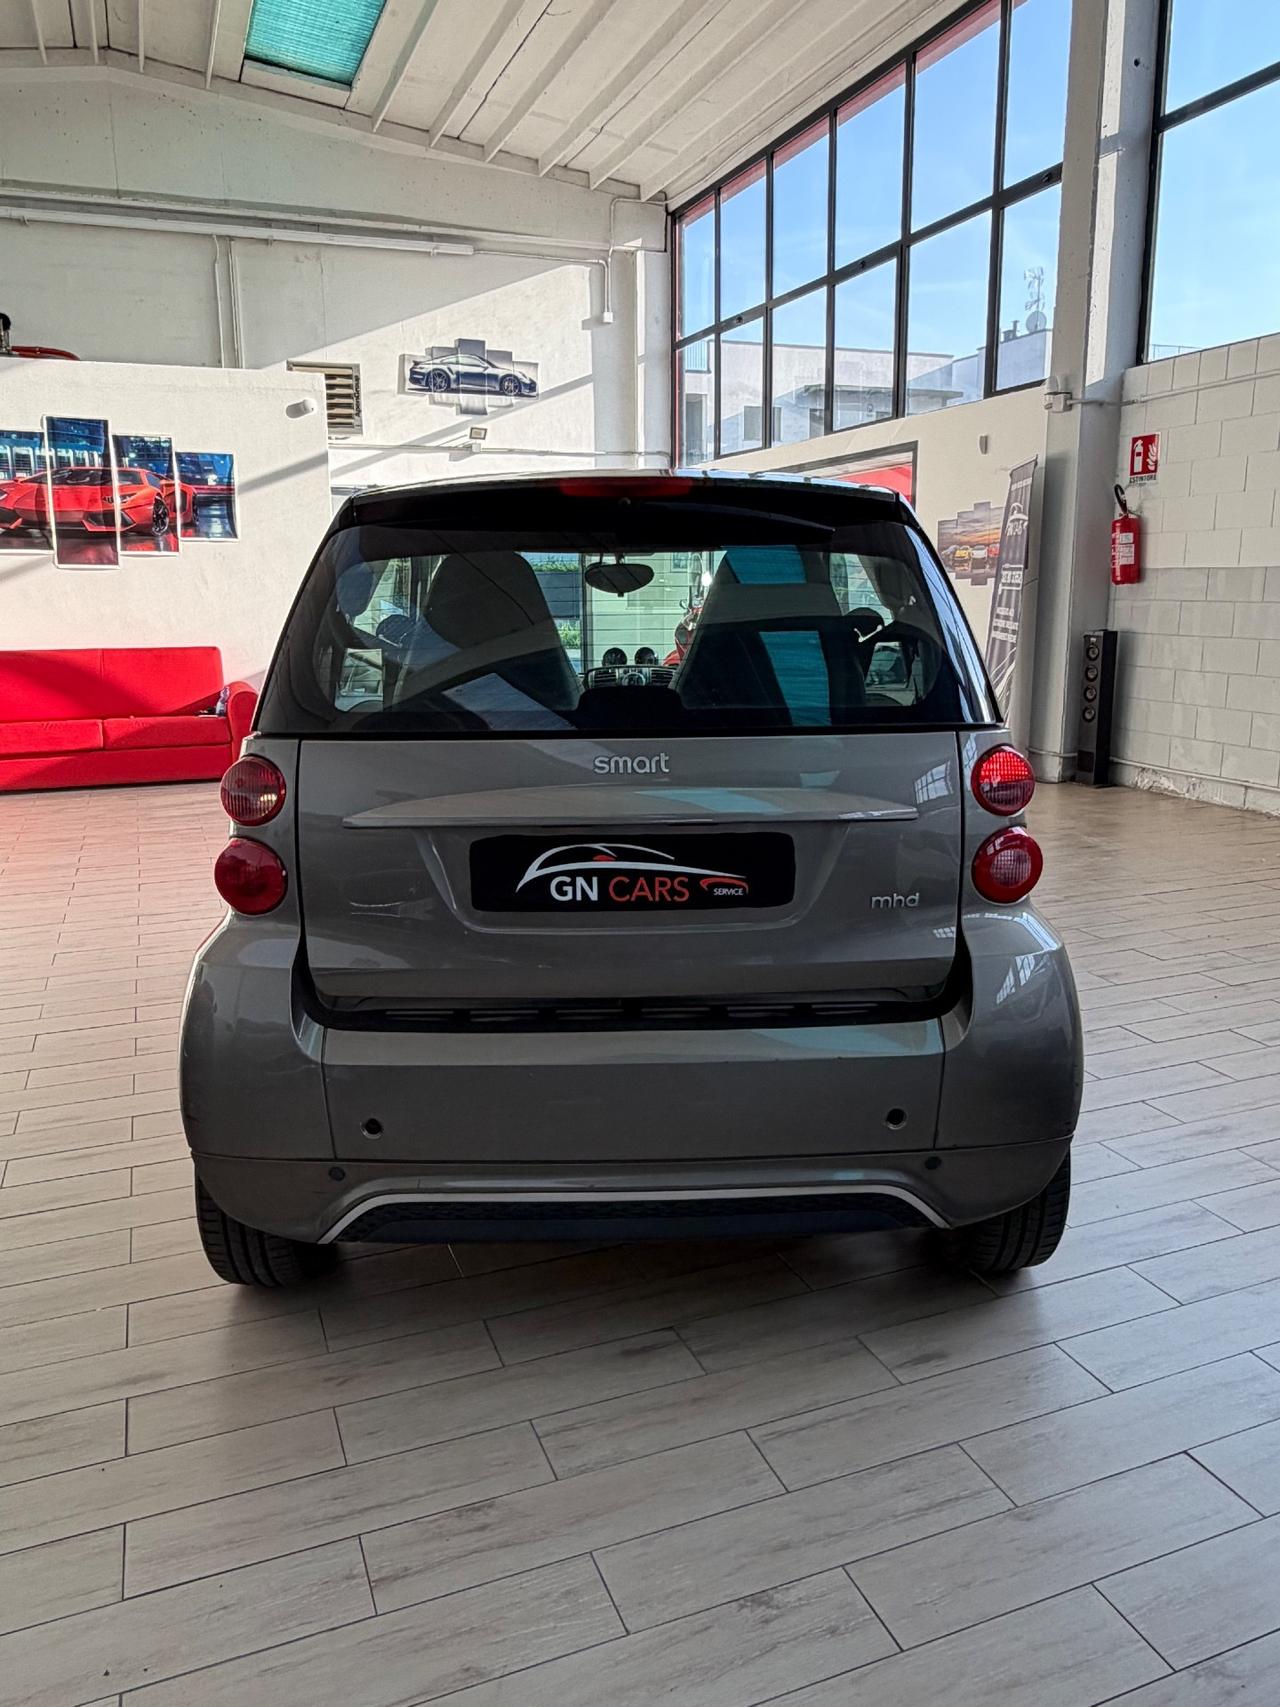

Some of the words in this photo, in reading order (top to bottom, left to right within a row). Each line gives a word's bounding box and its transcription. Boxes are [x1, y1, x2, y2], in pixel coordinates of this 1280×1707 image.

[594, 752, 670, 774] smart
[550, 875, 598, 901] GN
[608, 876, 690, 902] CARS
[713, 887, 743, 896] SERVICE
[871, 892, 920, 909] mhd
